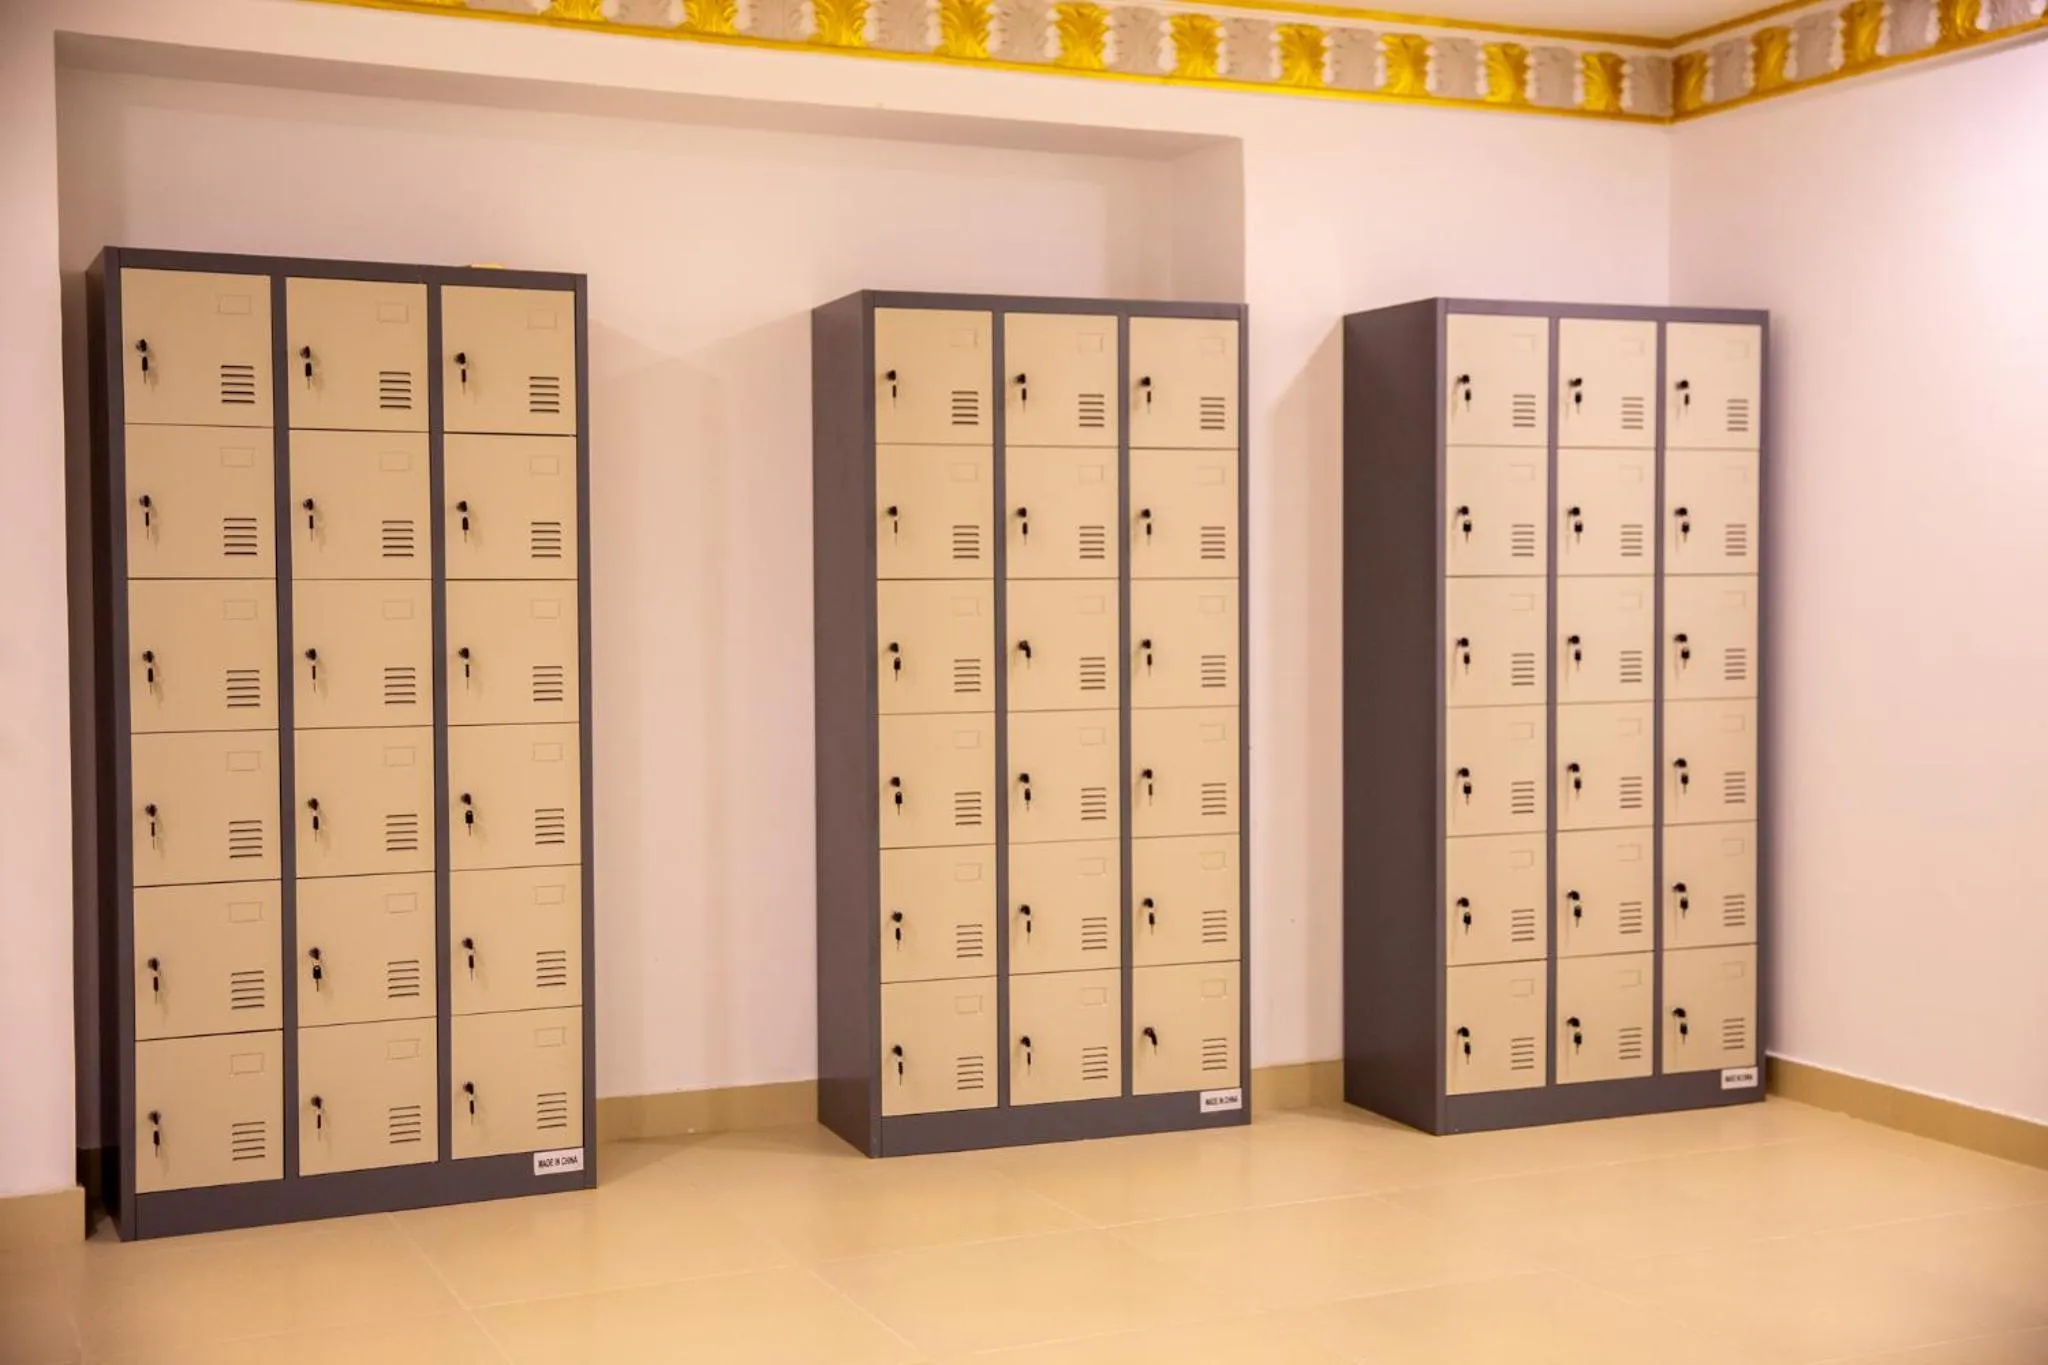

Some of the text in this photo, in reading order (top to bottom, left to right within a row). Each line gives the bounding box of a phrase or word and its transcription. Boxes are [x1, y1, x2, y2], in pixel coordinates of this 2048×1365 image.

[538, 1154, 578, 1168] MADE IN CHINA
